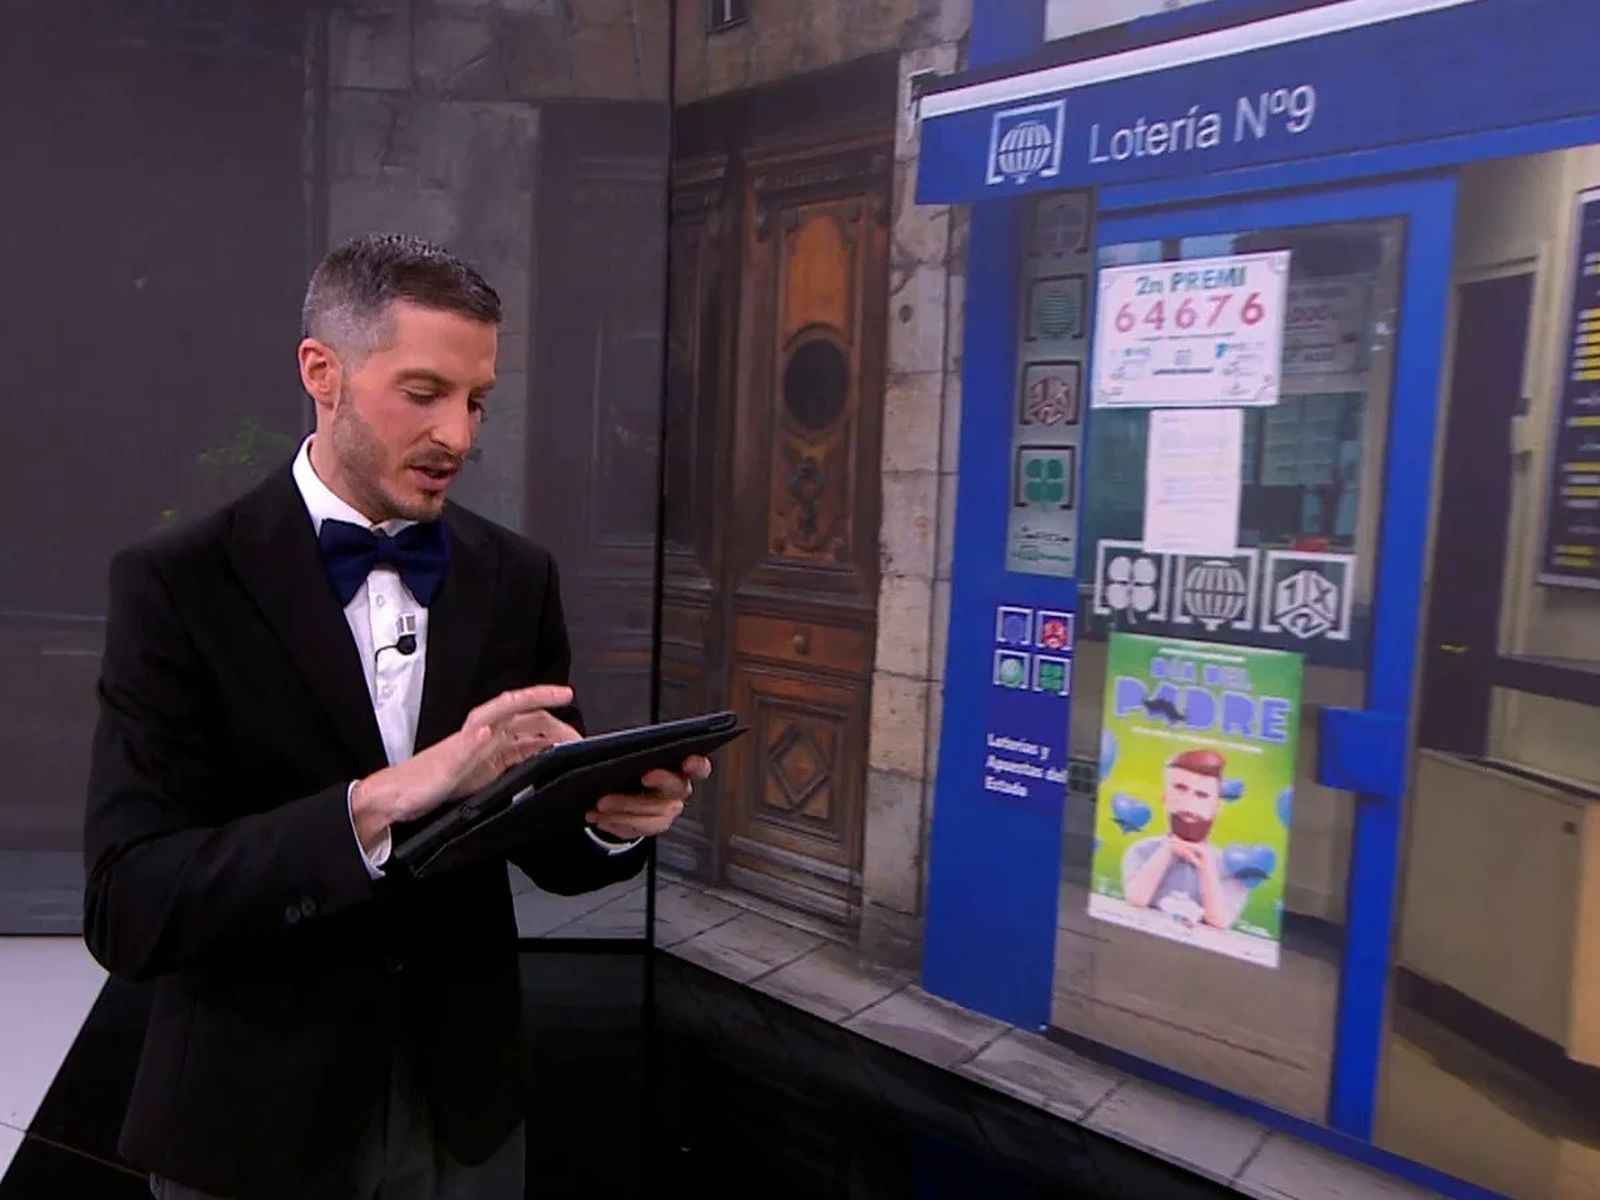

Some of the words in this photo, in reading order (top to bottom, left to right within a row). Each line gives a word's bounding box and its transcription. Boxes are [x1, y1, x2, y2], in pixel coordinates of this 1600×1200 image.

[1088, 105, 1221, 164] Lotería
[1136, 275, 1163, 295] 2n
[1170, 266, 1247, 292] PREMI
[1115, 292, 1264, 333] 64676
[1114, 675, 1291, 743] PADRE
